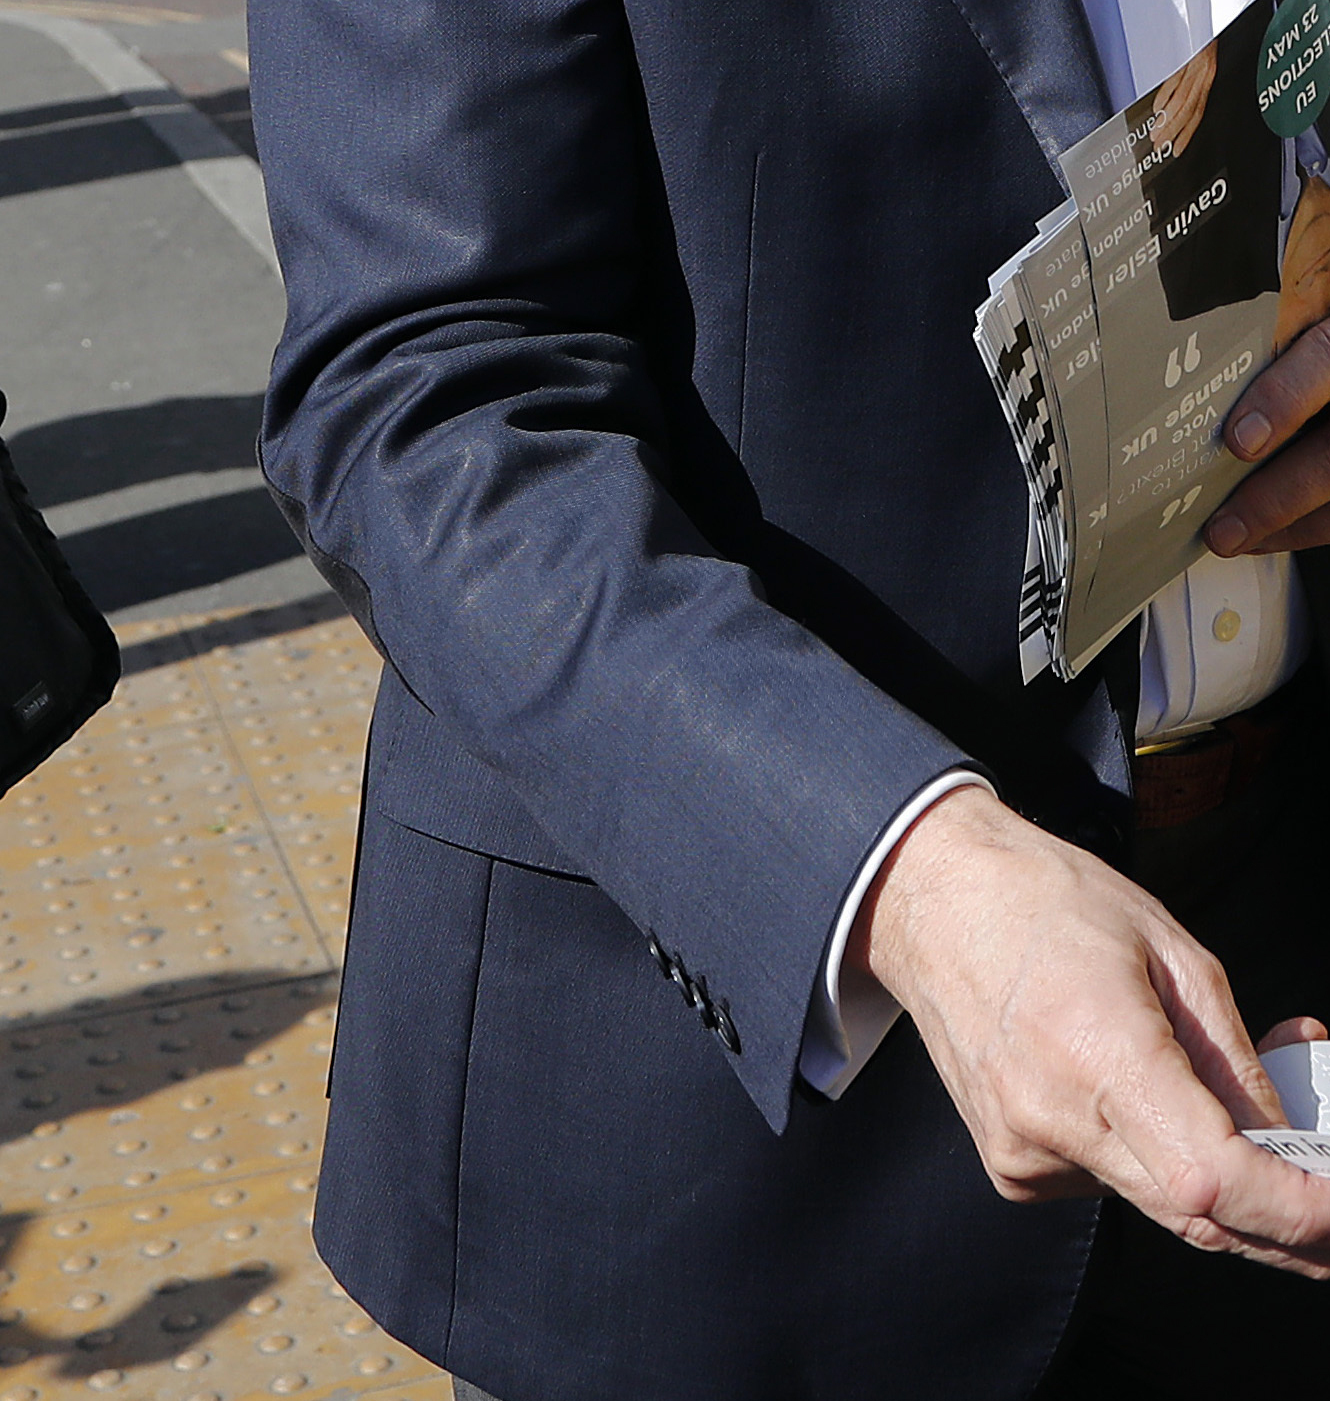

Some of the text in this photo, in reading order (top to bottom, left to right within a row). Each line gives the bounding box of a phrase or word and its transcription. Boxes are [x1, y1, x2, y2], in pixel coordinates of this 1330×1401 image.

[1265, 3, 1320, 70] 23 MAY
[1295, 80, 1318, 114] EU
[1083, 109, 1168, 180] Candidate
[1081, 139, 1173, 223] Change UK
[1092, 199, 1153, 258] London
[1105, 178, 1228, 293] Gavin Esler
[1044, 238, 1083, 279] date
[1039, 286, 1068, 318] UK
[1049, 303, 1094, 349] ndon
[1120, 349, 1253, 465] Change UK
[1171, 404, 1217, 445] Vote
[1115, 448, 1186, 505] Brexit?
[1151, 477, 1171, 496] to
